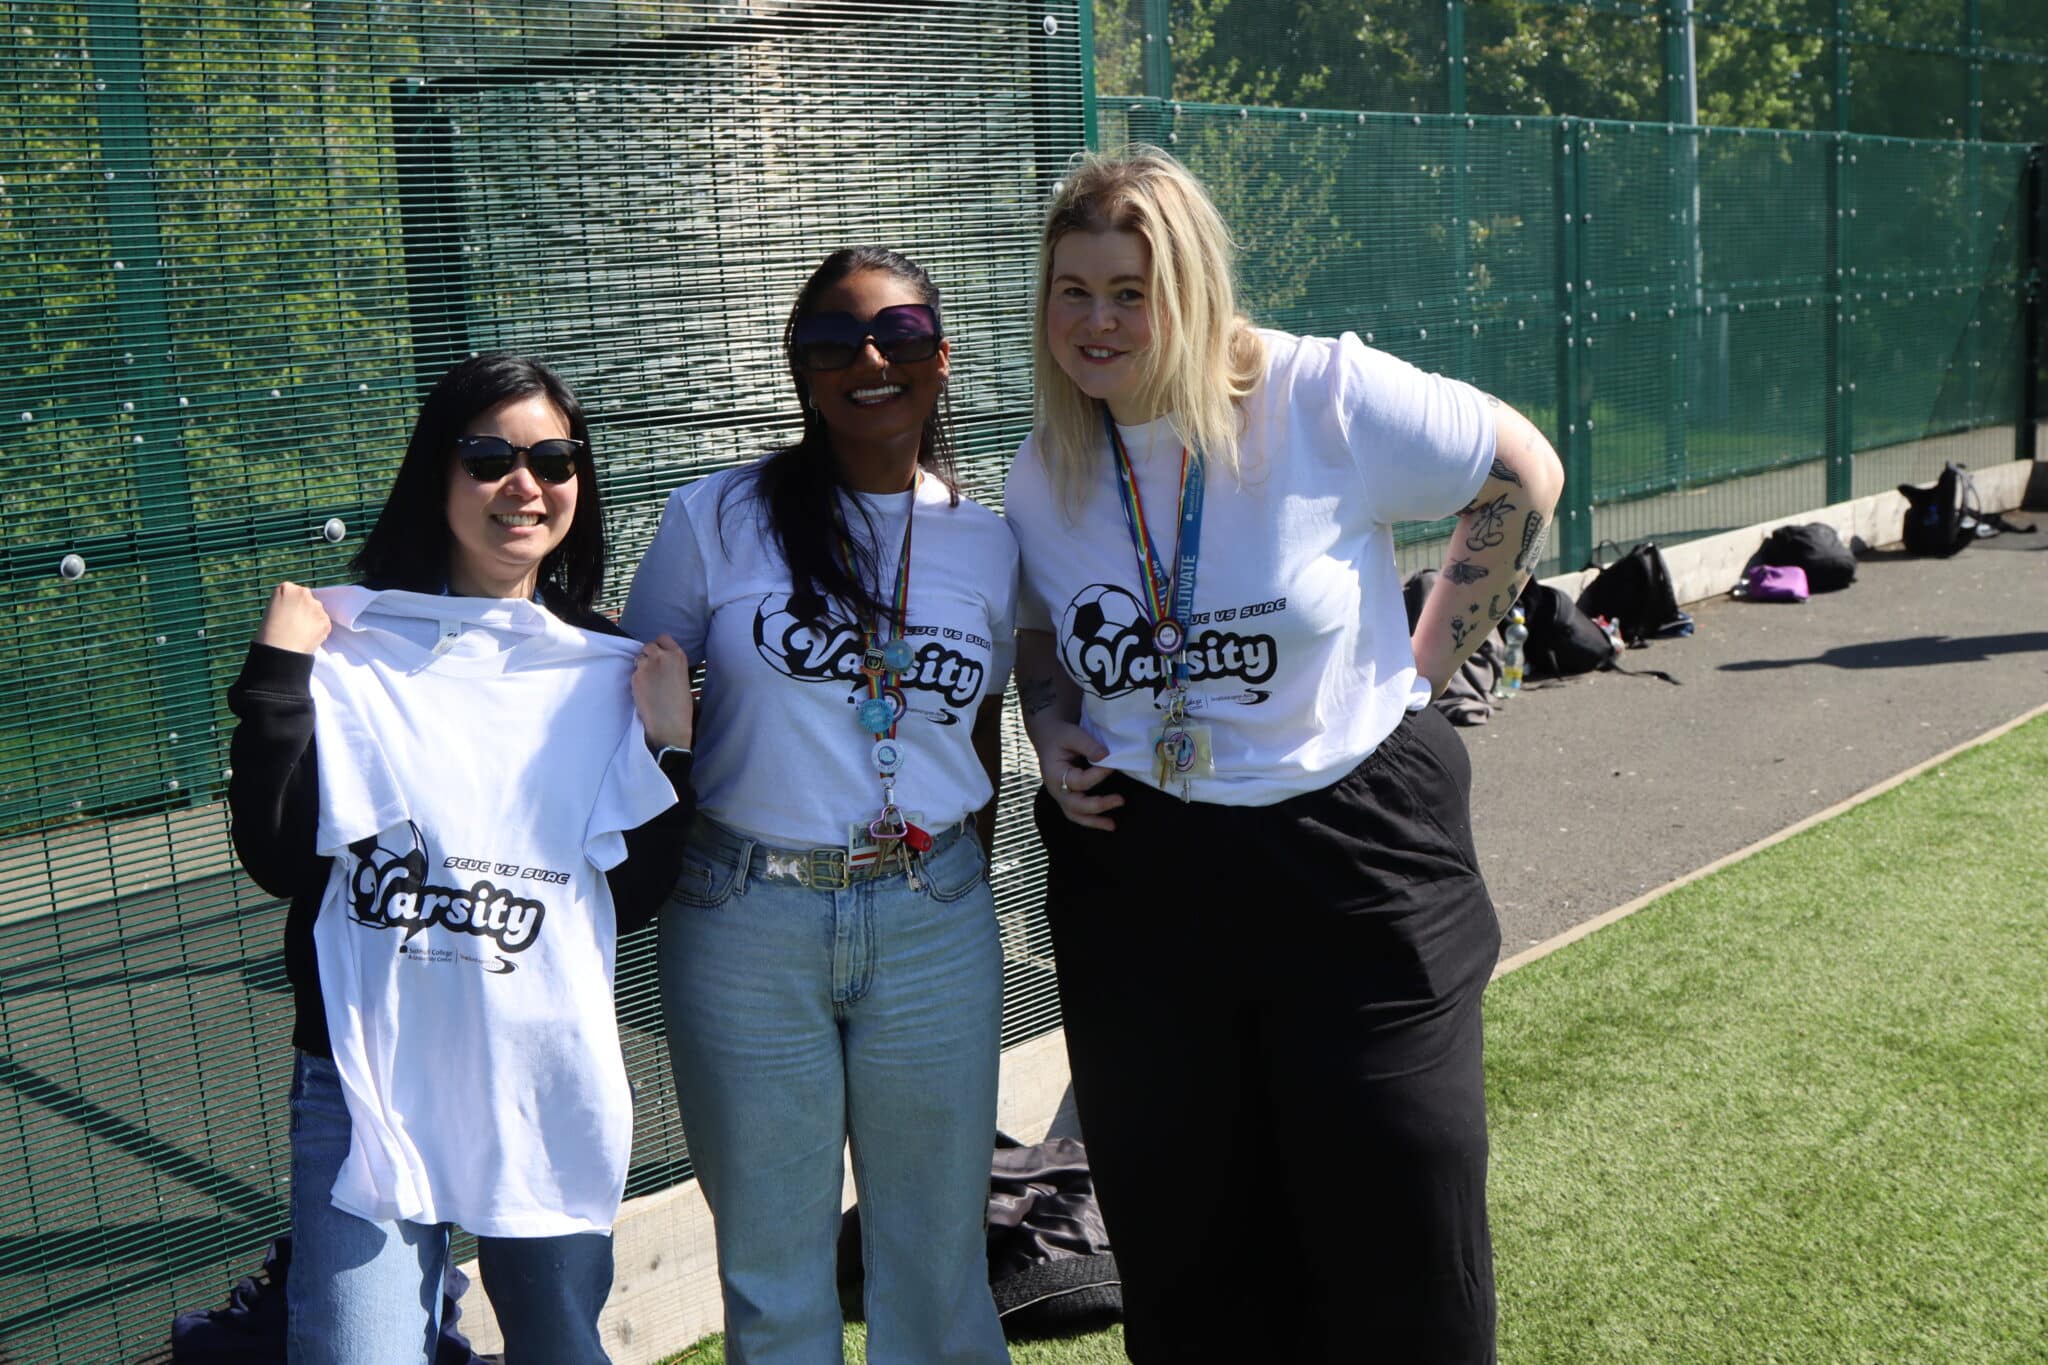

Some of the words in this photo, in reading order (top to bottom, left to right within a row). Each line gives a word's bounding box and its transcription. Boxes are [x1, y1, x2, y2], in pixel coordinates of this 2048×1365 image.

[1191, 613, 1210, 625] UC
[1215, 608, 1236, 622] VS
[1240, 598, 1287, 618] SUAC
[904, 626, 938, 637] CUC
[942, 627, 962, 640] VS
[782, 621, 984, 708] Vasity
[444, 857, 490, 872] SCUC
[494, 863, 519, 877] VS
[521, 867, 570, 884] SUAC
[353, 859, 545, 953] Varsity
